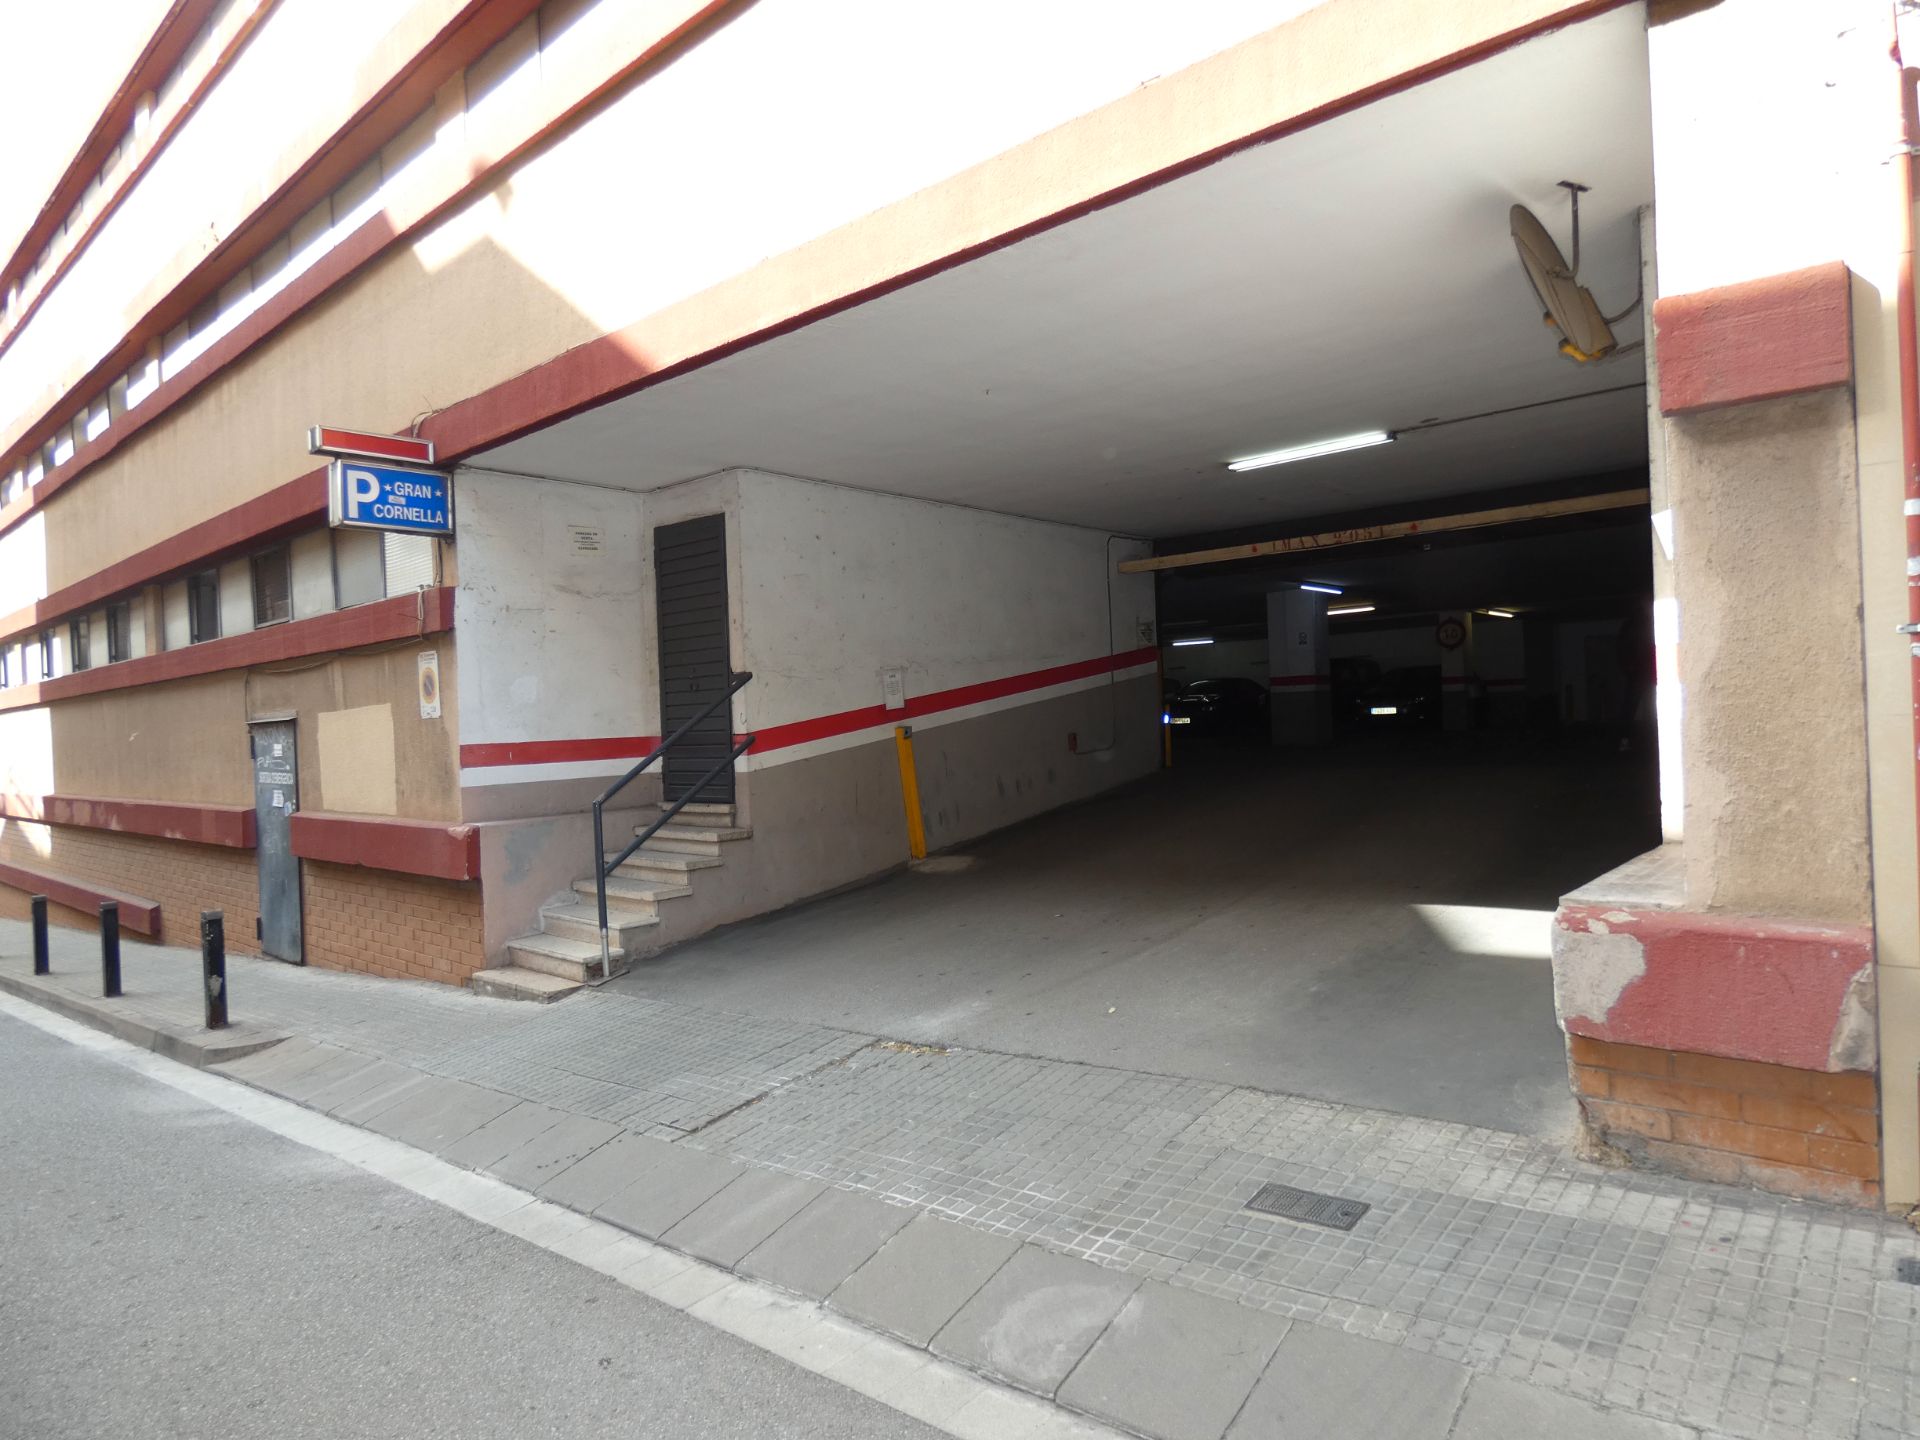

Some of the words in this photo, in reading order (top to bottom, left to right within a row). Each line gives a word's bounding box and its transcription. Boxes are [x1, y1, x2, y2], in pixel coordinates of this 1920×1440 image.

[346, 469, 381, 519] P
[394, 481, 432, 499] GRAN
[373, 503, 444, 524] CORNELLA
